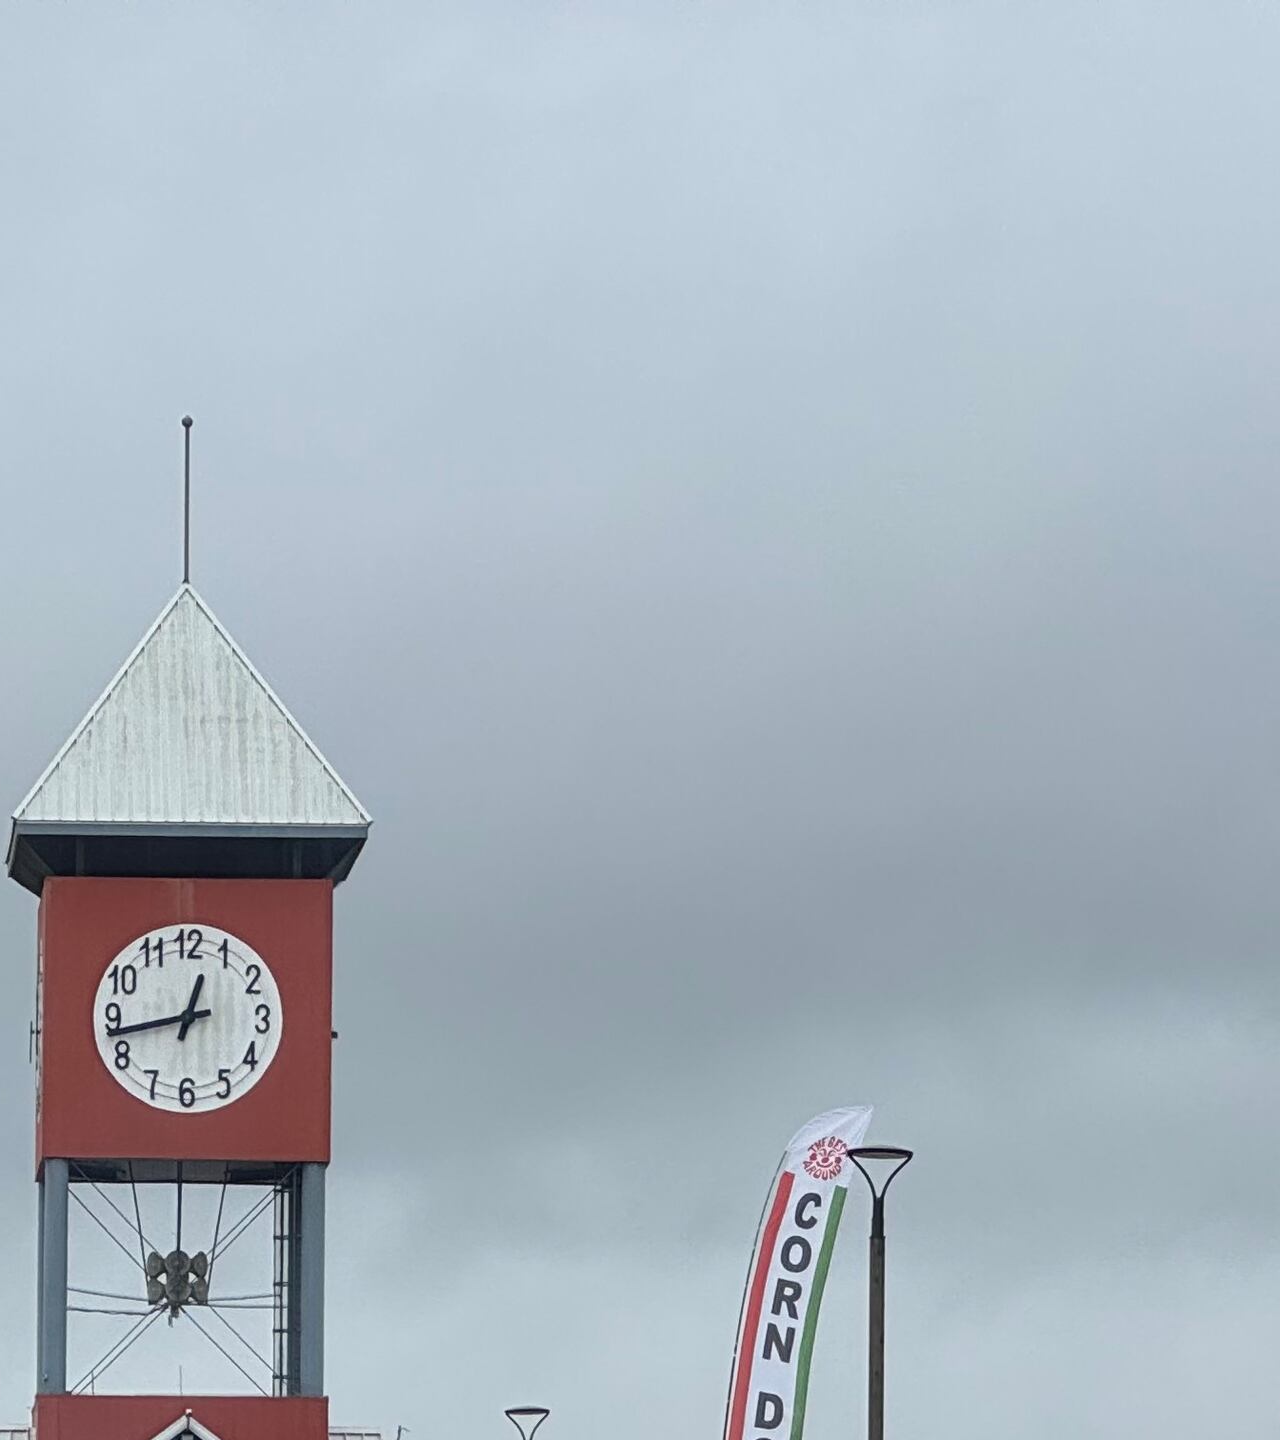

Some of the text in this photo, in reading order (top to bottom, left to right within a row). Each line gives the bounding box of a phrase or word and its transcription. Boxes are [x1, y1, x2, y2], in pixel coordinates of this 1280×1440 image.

[140, 937, 163, 968] 11
[174, 929, 203, 959] 12
[218, 938, 228, 969] 1
[108, 965, 137, 995] 10
[245, 965, 261, 994] 2
[105, 1003, 121, 1034] 9
[255, 1004, 270, 1034] 3
[115, 1041, 130, 1070] 8
[243, 1041, 258, 1072] 4
[144, 1069, 159, 1100] 7
[179, 1078, 195, 1108] 6
[216, 1069, 231, 1099] 5
[762, 1193, 822, 1363] CORN
